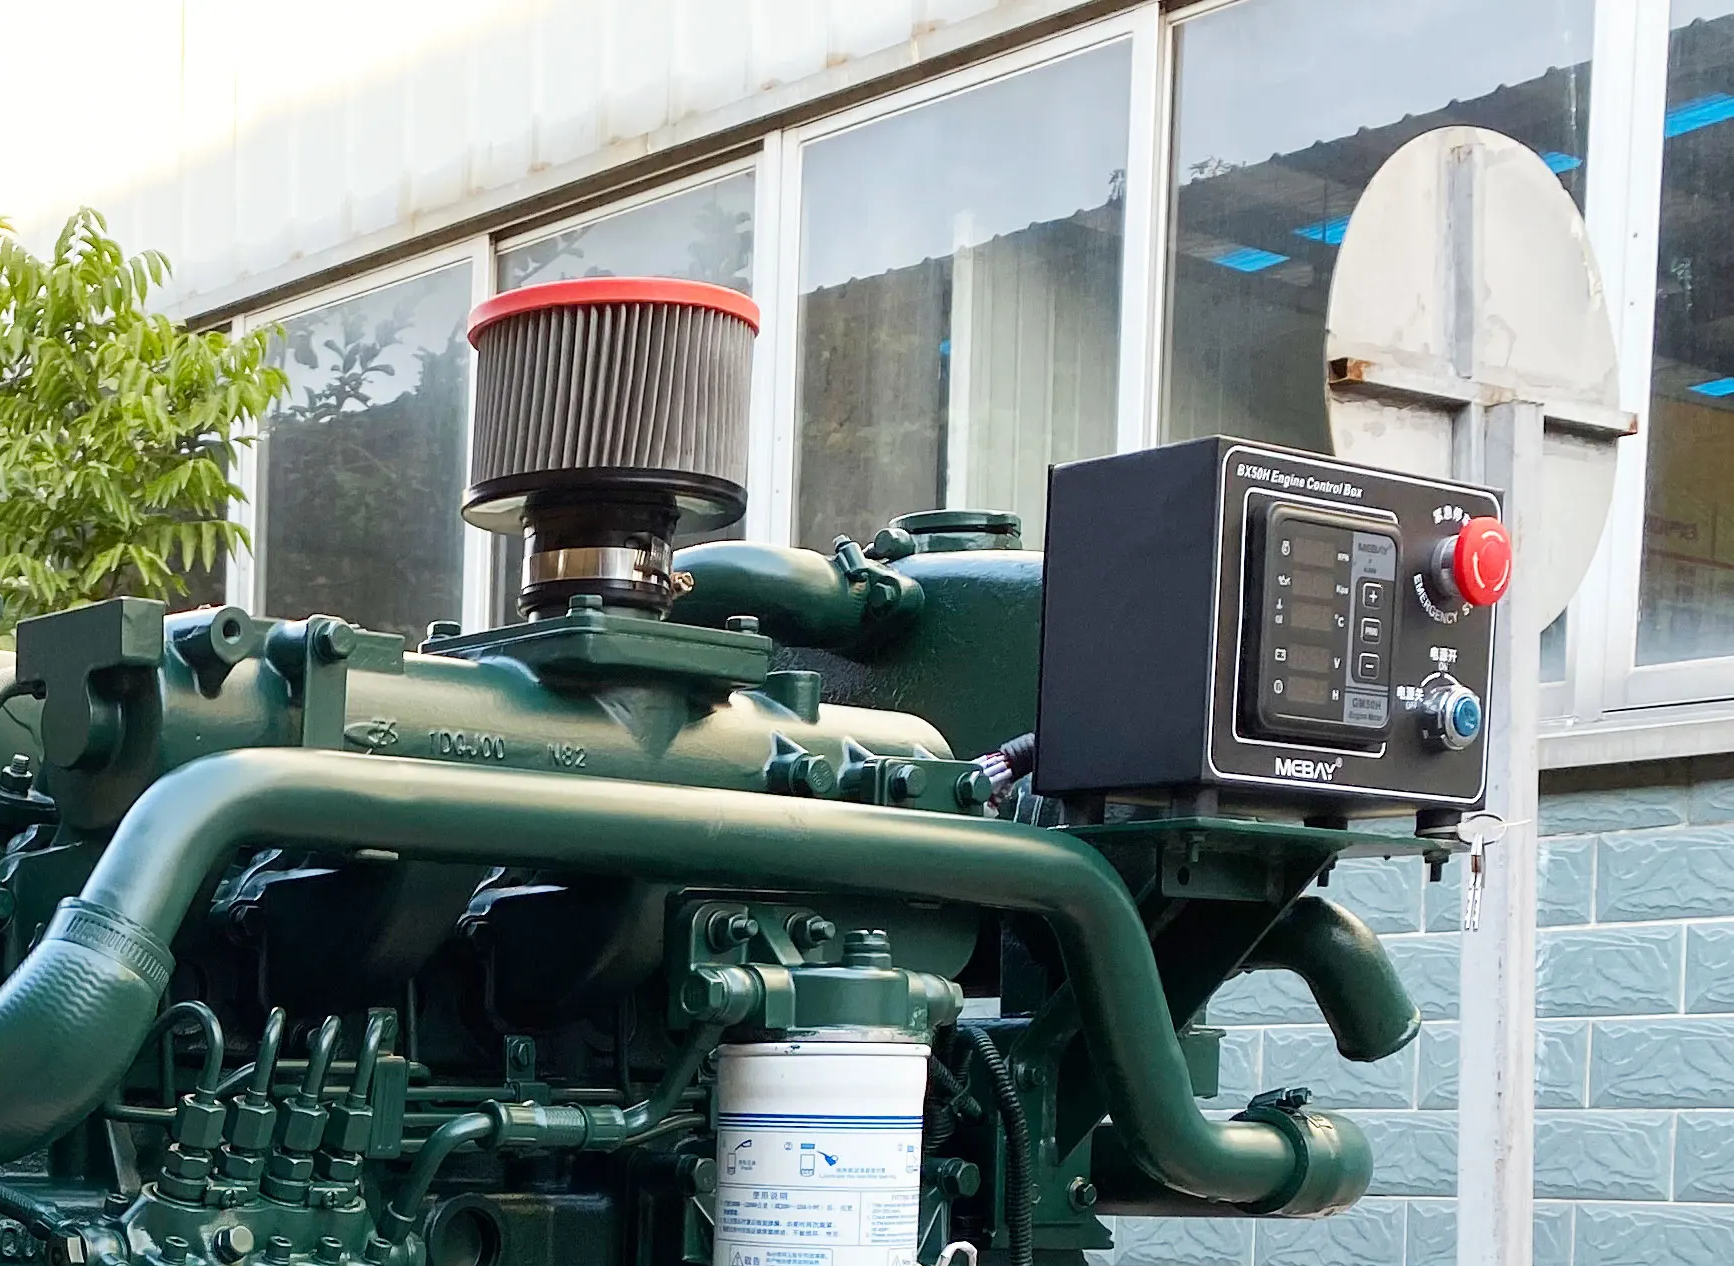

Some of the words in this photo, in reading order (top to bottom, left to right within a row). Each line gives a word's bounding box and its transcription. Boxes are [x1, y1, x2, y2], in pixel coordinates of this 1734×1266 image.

[1236, 463, 1271, 481] BX50H
[1271, 470, 1305, 488] Engine
[1306, 477, 1344, 495] Control
[1343, 483, 1364, 498] Box
[1413, 573, 1458, 624] EMERGENCY
[1429, 646, 1458, 662] 电源开
[1333, 657, 1342, 669] V
[1438, 662, 1448, 671] ON
[1331, 689, 1340, 700] H
[1396, 685, 1425, 702] 电源关
[1274, 756, 1336, 780] MEBAY
[752, 1191, 788, 1201] 使用说明
